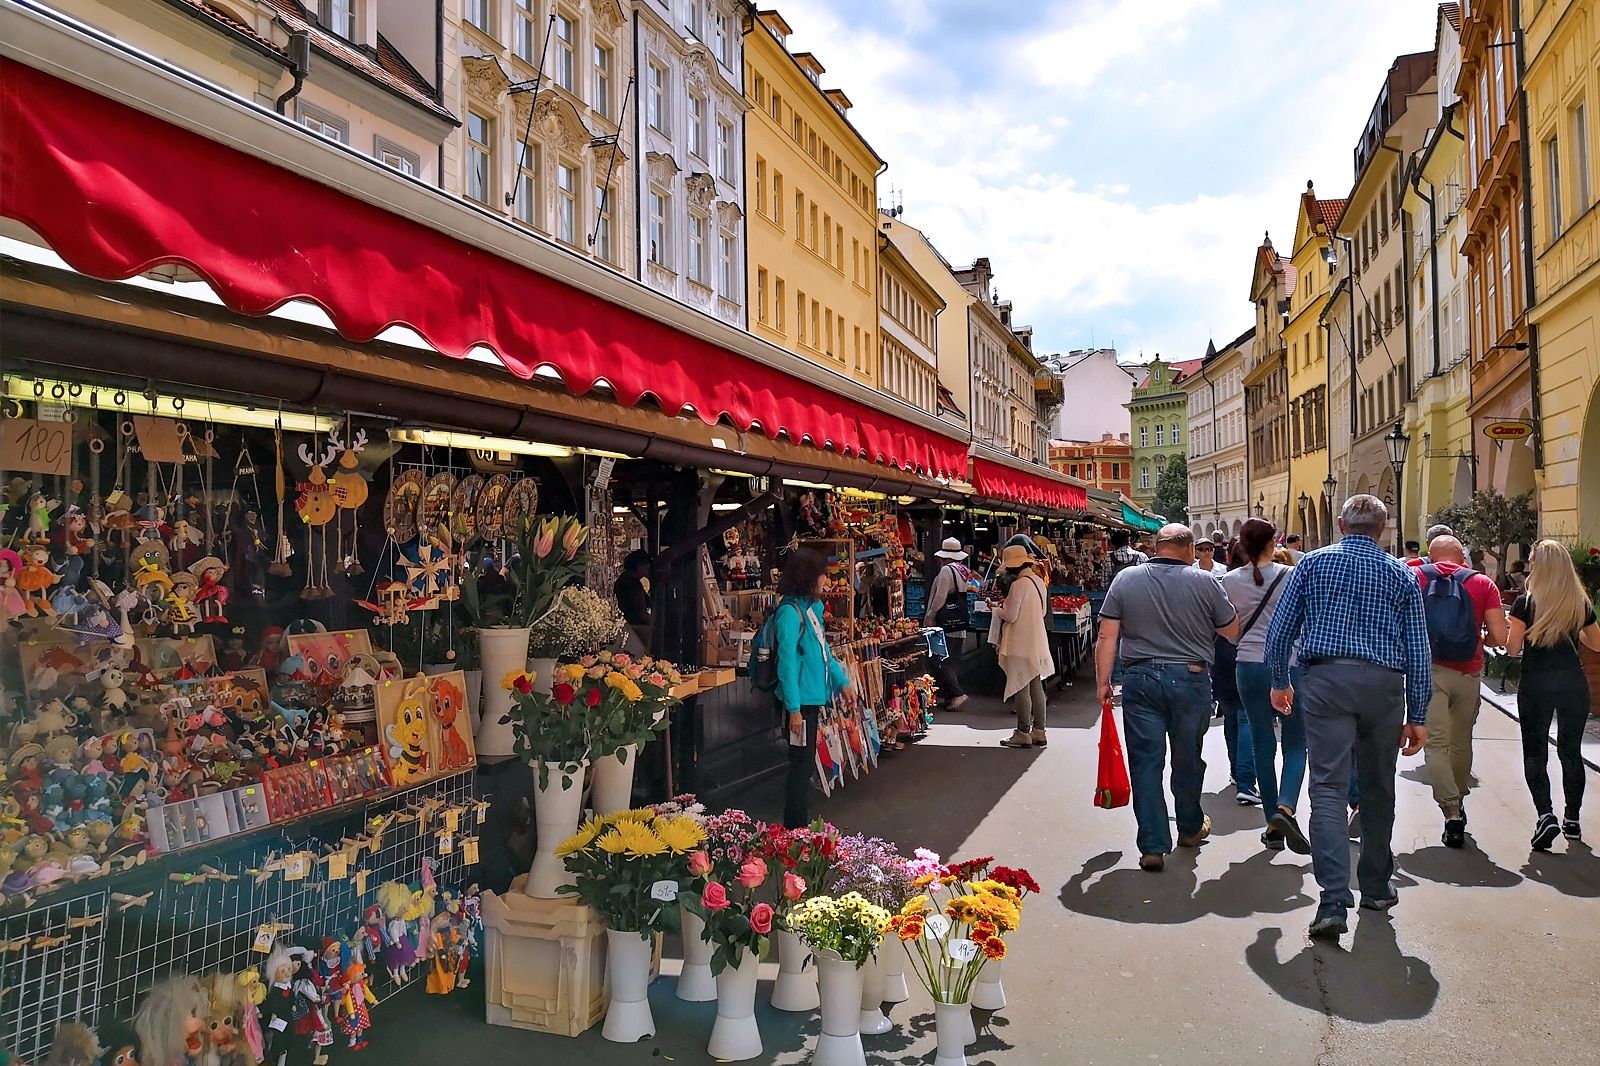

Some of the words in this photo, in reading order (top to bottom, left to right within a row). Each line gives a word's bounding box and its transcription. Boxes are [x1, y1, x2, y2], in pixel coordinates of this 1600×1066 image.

[16, 425, 70, 472] 180,-
[239, 467, 255, 475] PRAHA
[958, 943, 975, 957] 19,-
